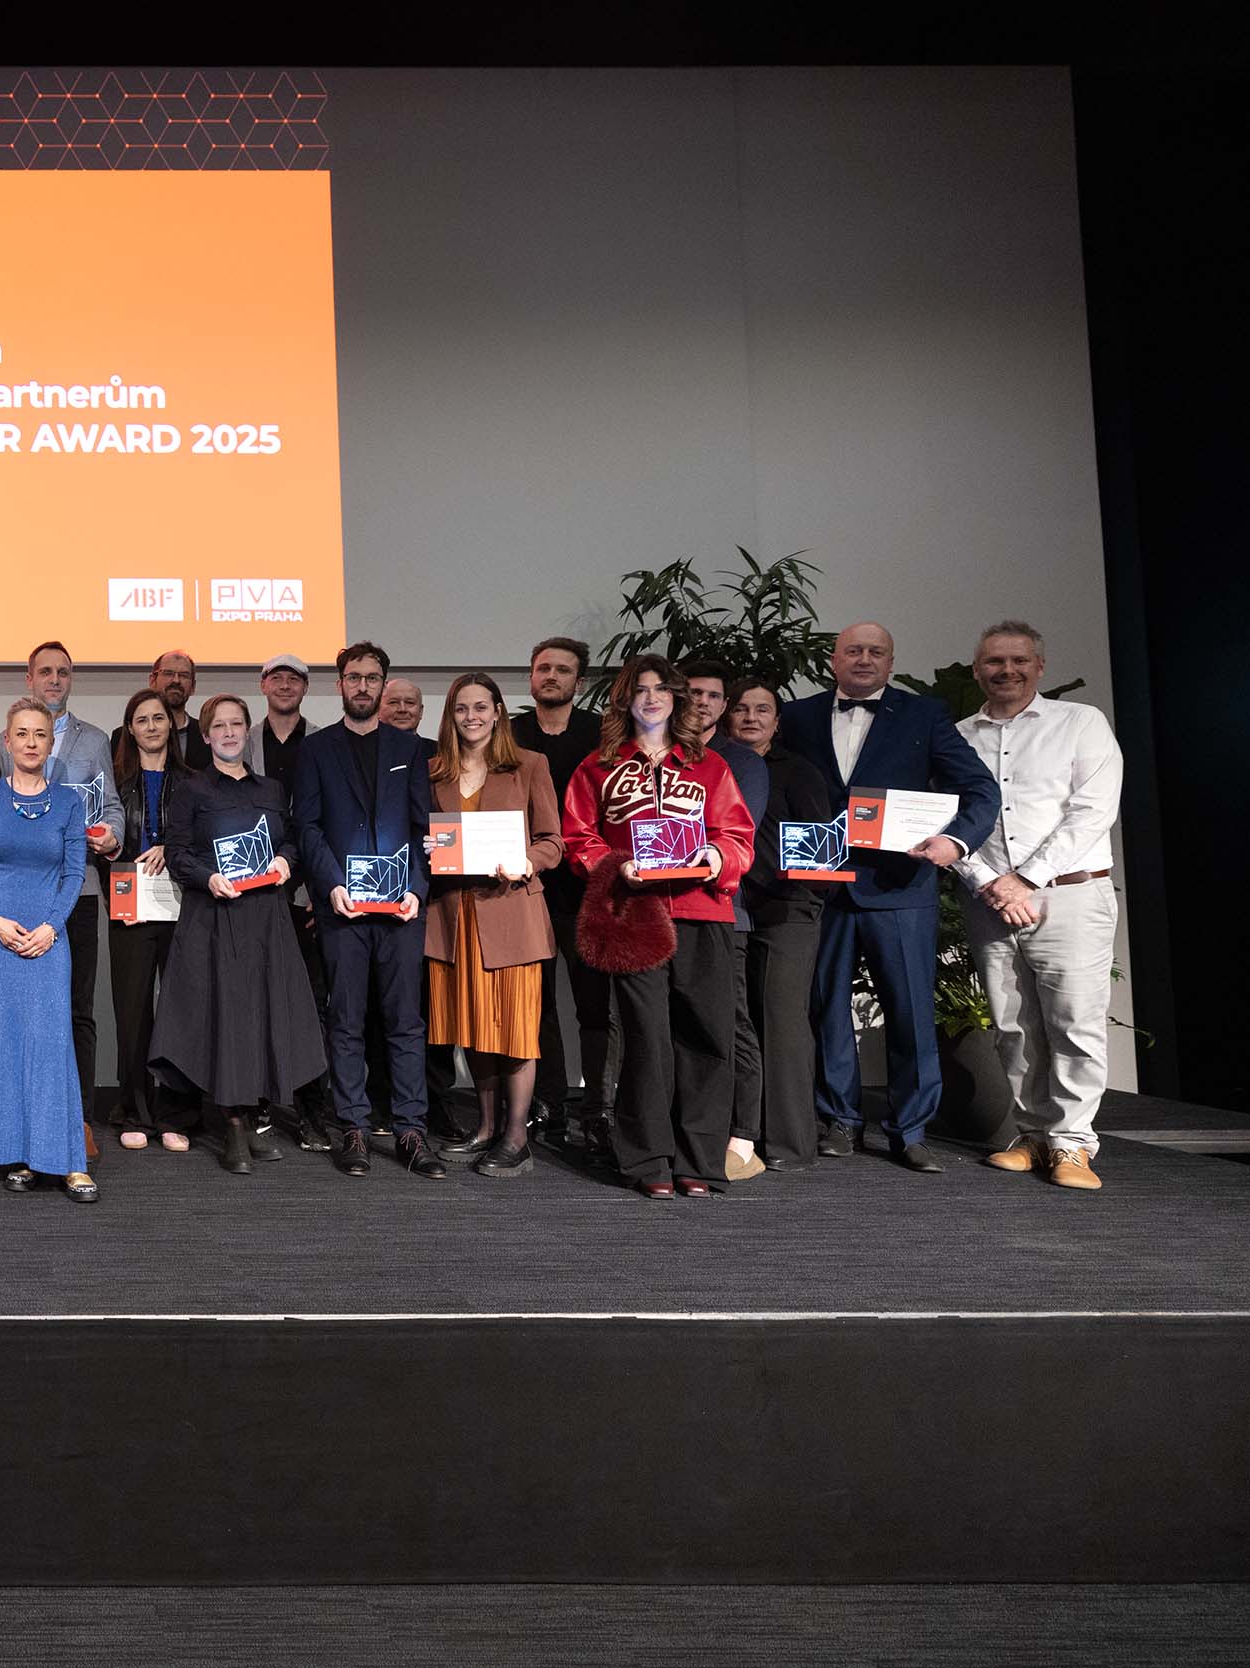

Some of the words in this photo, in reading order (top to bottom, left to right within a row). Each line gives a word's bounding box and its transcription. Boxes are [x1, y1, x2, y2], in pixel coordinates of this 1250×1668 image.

[30, 423, 181, 453] AWARD
[190, 424, 282, 454] 2025
[119, 587, 175, 608] ABF
[216, 584, 300, 606] PVA
[211, 611, 252, 623] EXPO
[254, 611, 303, 623] PRAHA
